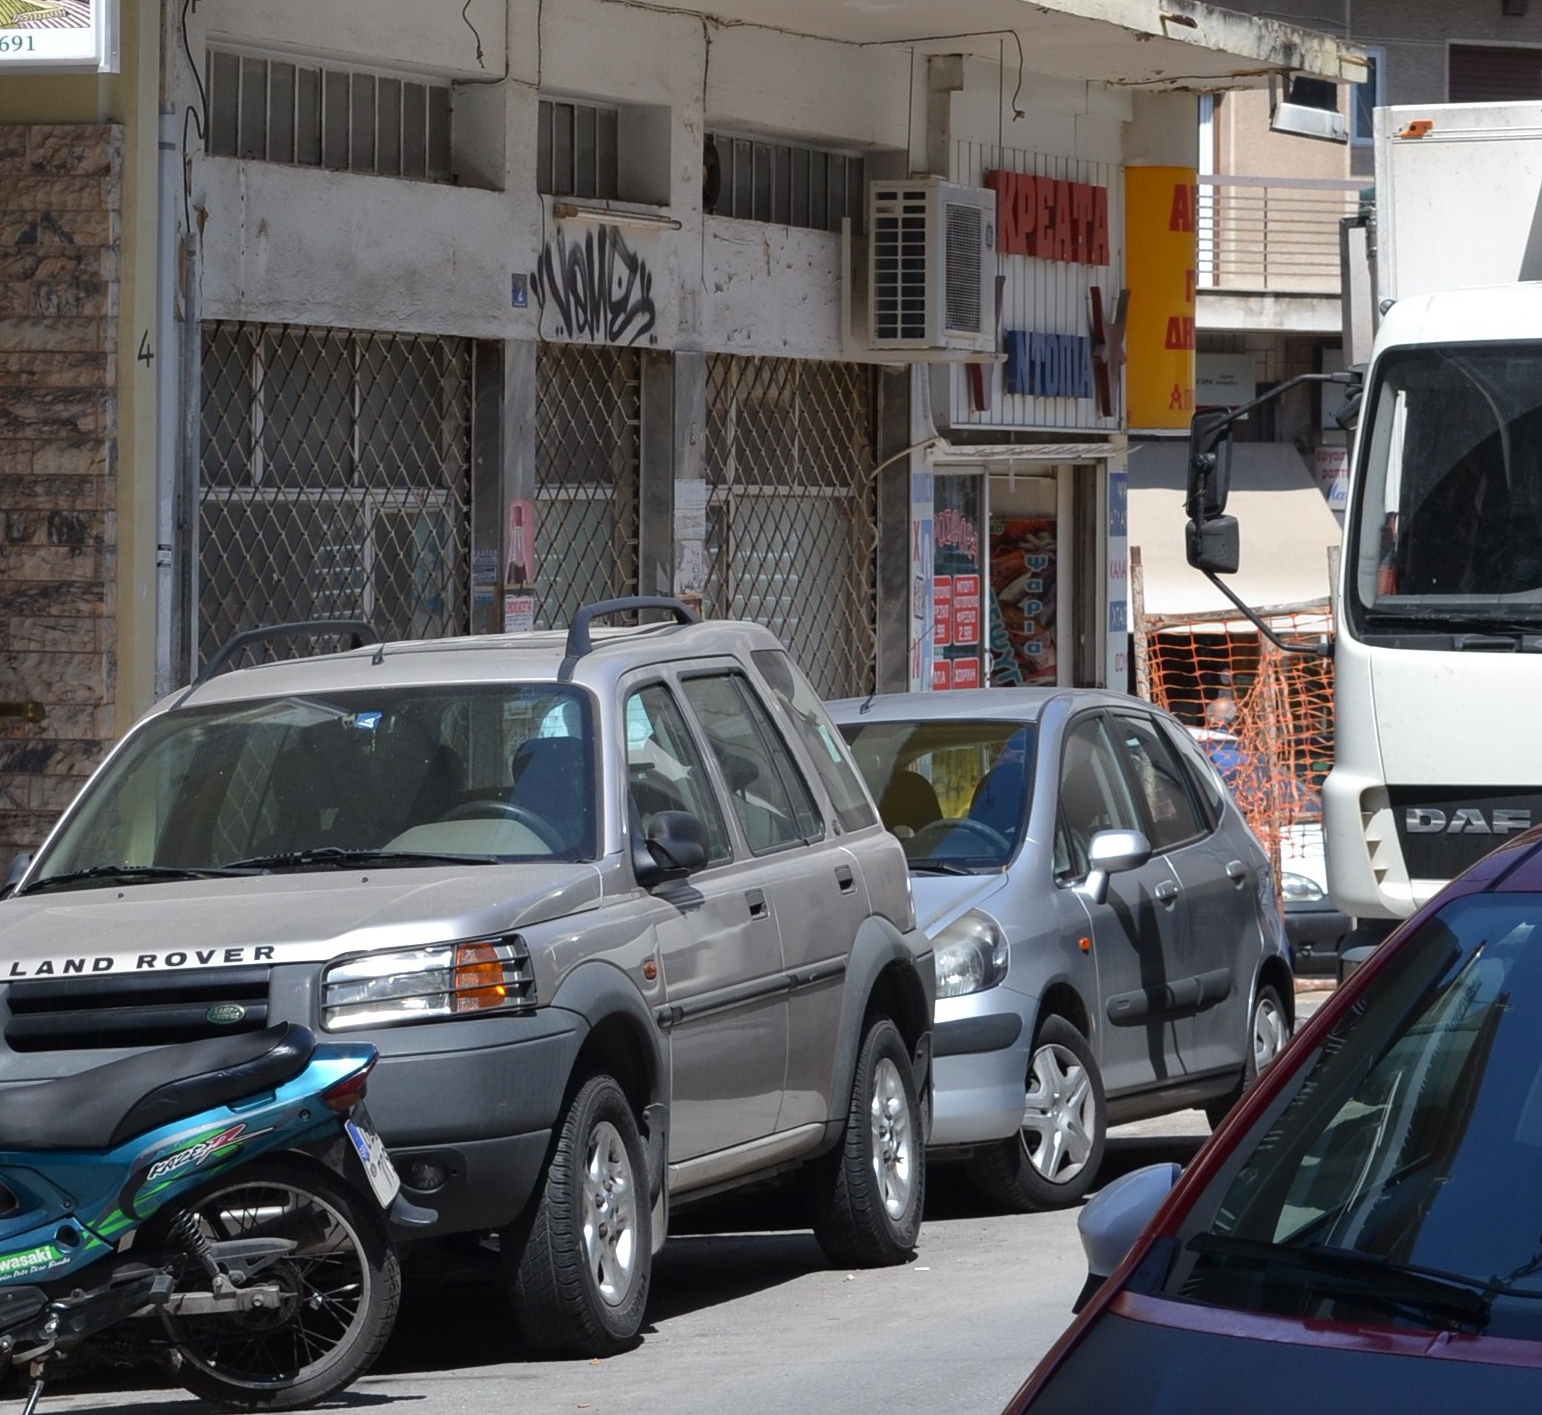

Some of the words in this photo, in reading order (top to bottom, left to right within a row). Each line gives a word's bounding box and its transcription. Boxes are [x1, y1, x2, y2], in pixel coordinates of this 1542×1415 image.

[988, 170, 1109, 266] ΚΡΕΑΤΑ
[137, 329, 154, 368] 4
[1008, 330, 1093, 399] ΝΤΟΠΙΑ
[1405, 808, 1531, 834] DAF
[9, 957, 114, 977] LAND
[136, 946, 275, 969] ROVER
